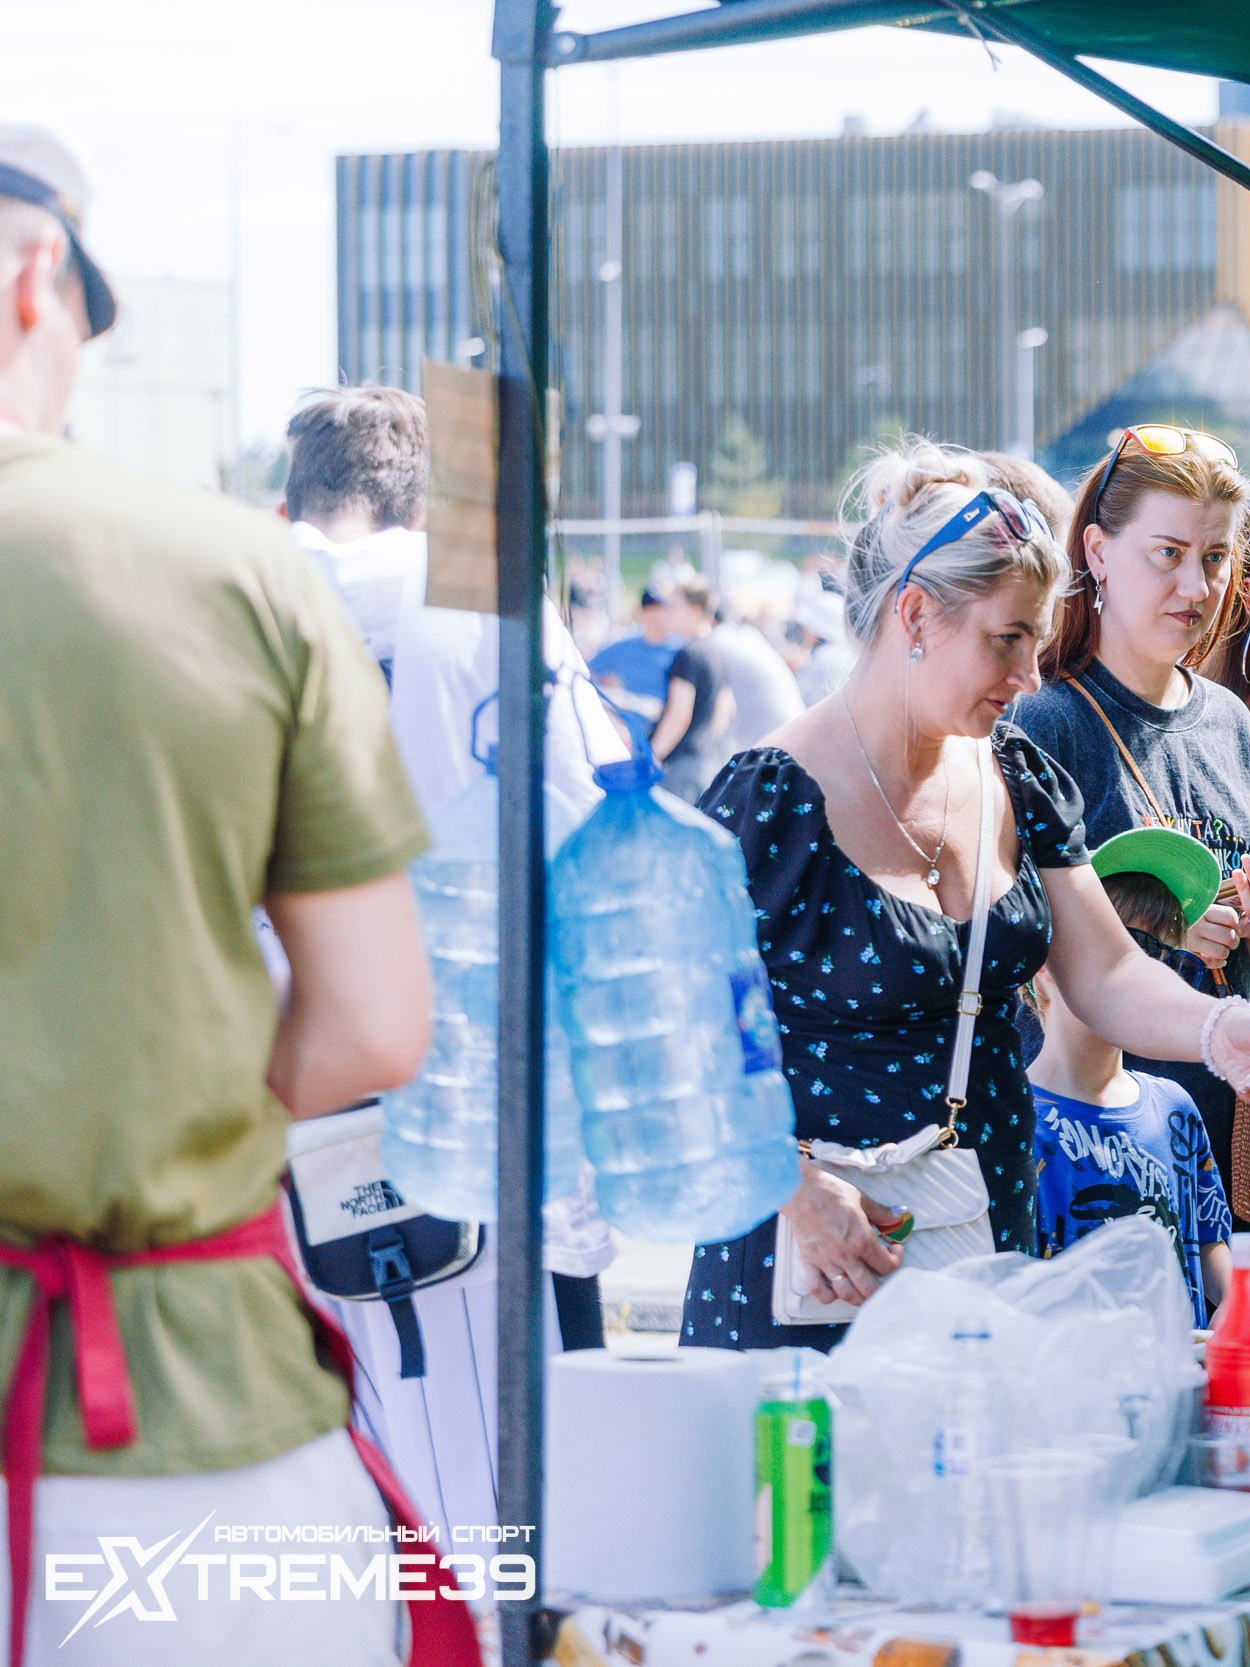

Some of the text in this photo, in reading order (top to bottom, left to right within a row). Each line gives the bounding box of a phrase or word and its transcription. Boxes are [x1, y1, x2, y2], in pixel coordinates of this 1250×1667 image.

[354, 1182, 382, 1197] THE
[340, 1192, 384, 1211] NORTH
[351, 1203, 387, 1218] FACE
